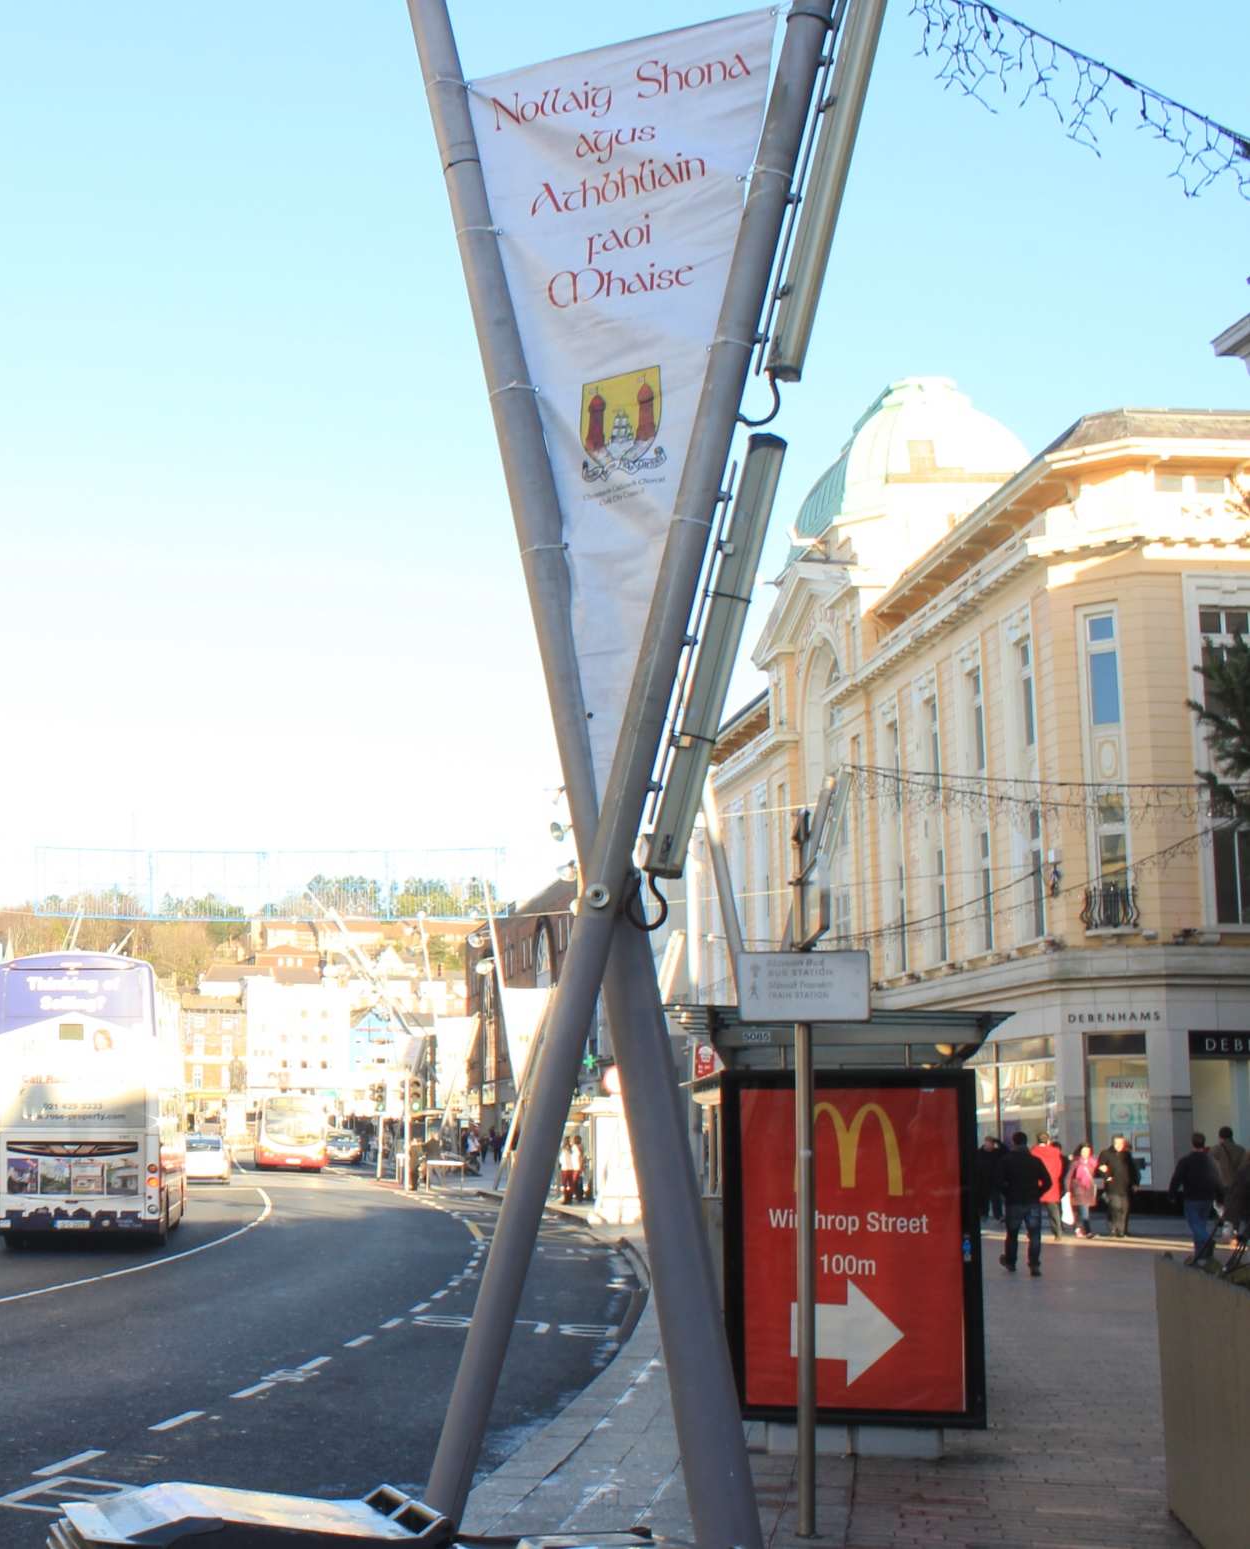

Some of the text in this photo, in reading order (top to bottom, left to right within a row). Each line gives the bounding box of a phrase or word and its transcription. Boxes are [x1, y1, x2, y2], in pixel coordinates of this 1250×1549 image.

[490, 53, 751, 131] Nollaig Shona
[575, 125, 656, 164] agus
[530, 152, 706, 217] Athbhliain
[586, 213, 652, 265] faoi
[547, 263, 696, 309] Mhaise
[1067, 1011, 1161, 1024] DEBENHAMS
[1111, 1080, 1135, 1089] NEW
[768, 1208, 929, 1236] Wihrop Street
[820, 1253, 877, 1276] 100m
